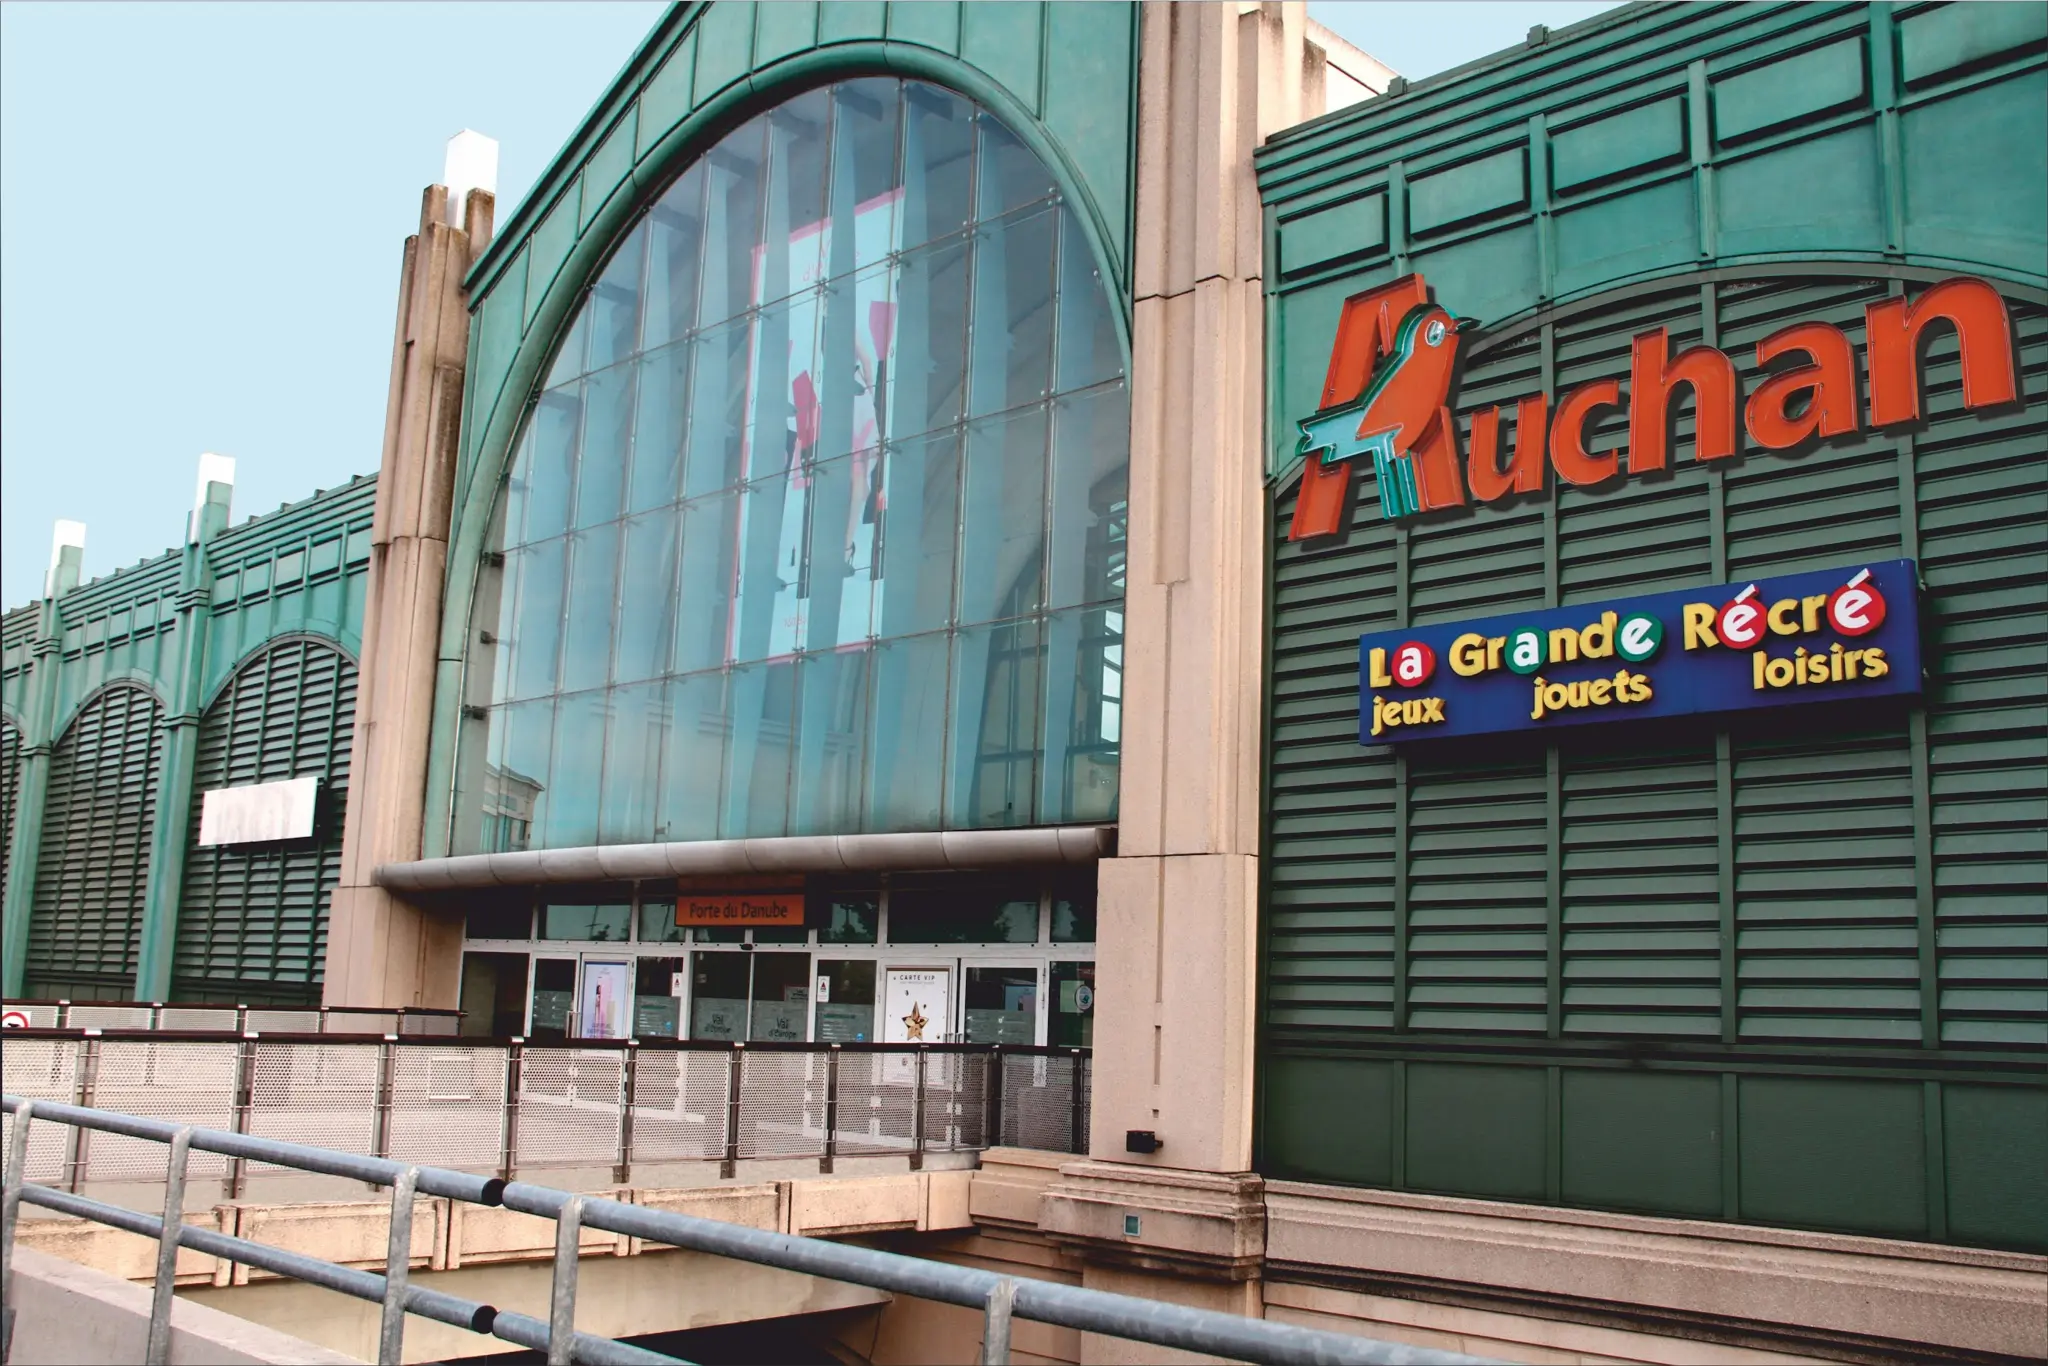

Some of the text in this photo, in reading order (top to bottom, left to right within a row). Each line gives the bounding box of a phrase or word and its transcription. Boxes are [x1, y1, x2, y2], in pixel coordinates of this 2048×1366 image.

[1289, 273, 2016, 541] Auchan
[1369, 568, 1882, 688] La Grande Récré
[1370, 642, 1889, 736] jeux jouets loisirs
[690, 901, 788, 918] Porte du Danube
[777, 1017, 789, 1029] Val
